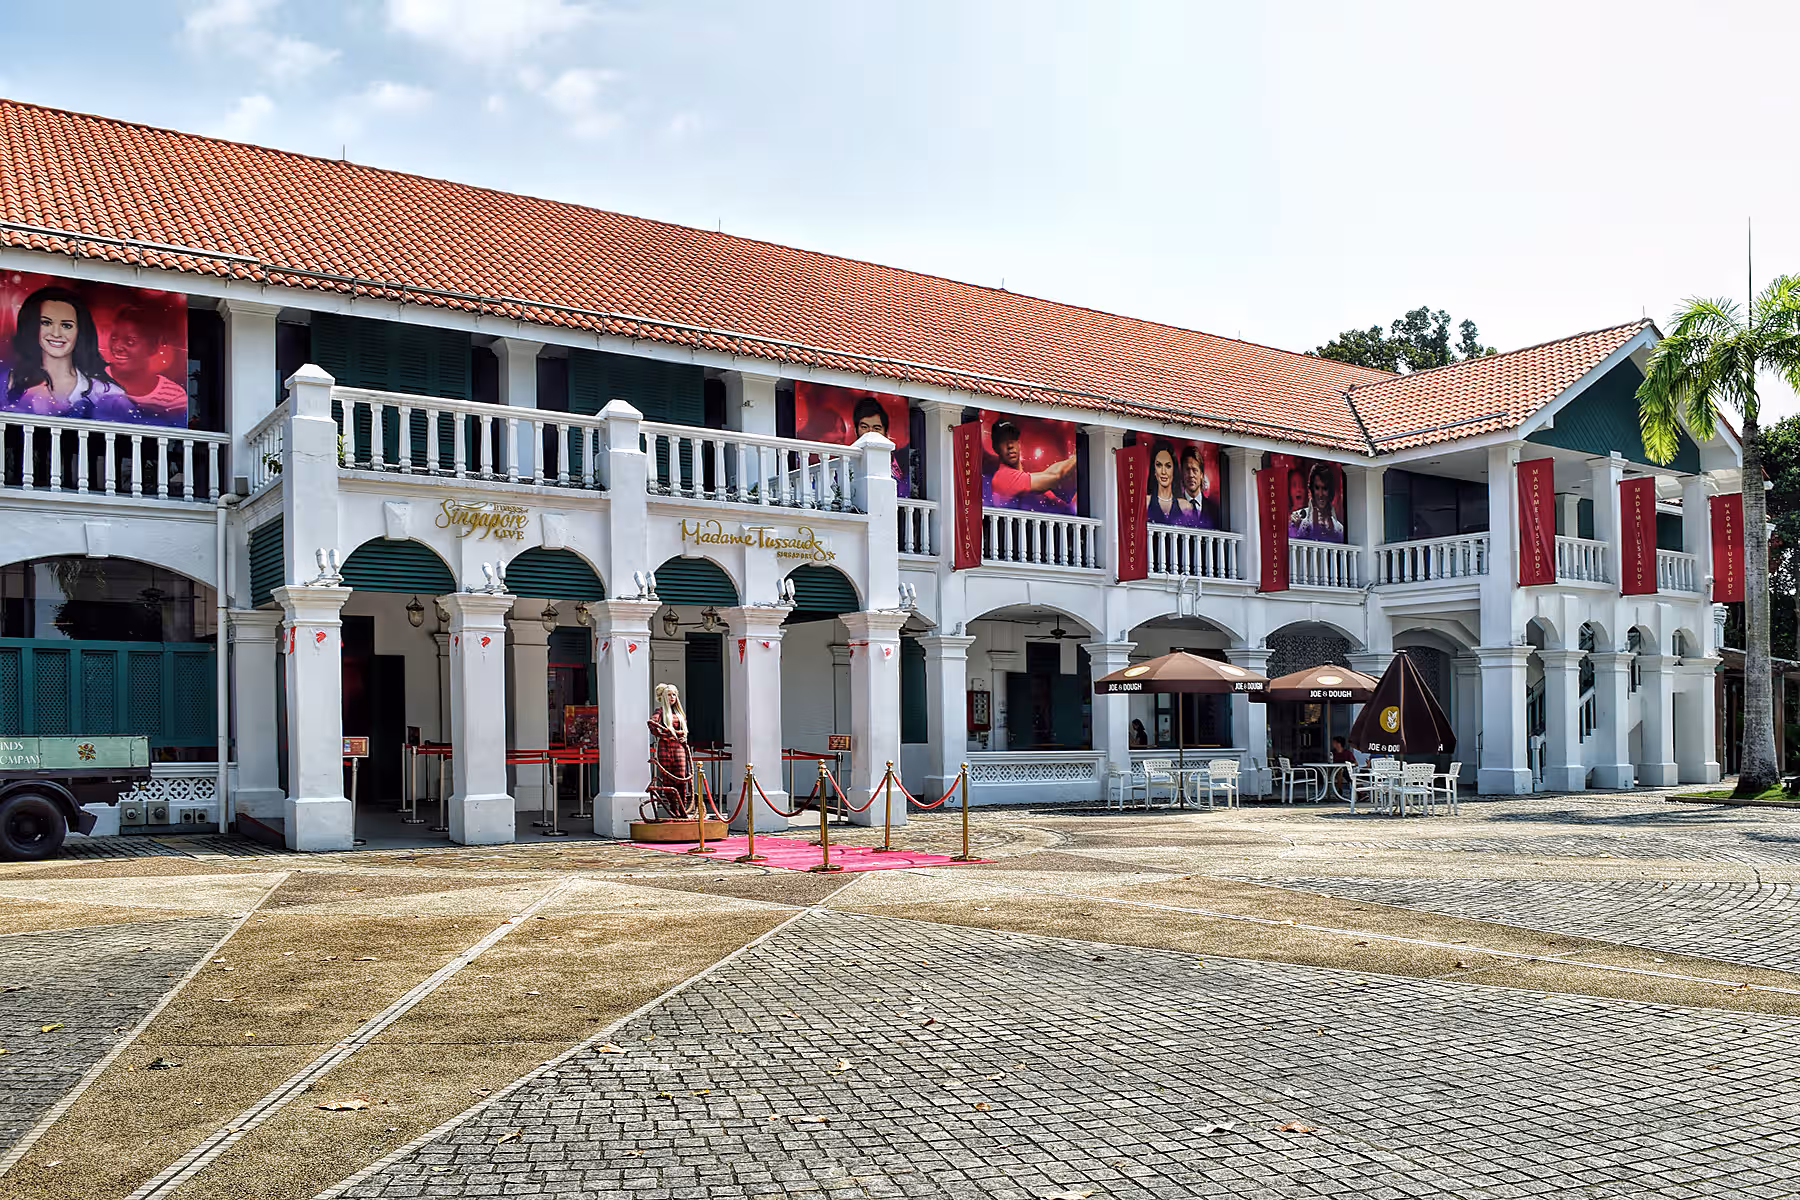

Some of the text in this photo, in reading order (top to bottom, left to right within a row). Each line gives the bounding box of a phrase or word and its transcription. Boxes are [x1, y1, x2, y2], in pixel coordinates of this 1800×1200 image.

[435, 499, 529, 539] Singapore
[494, 529, 524, 539] LIVE
[681, 519, 826, 561] Madame Tussauds
[1123, 683, 1142, 691] DOUGH
[1310, 690, 1322, 698] JOE
[1329, 690, 1352, 698] DOUGH
[1368, 743, 1380, 751] JOE
